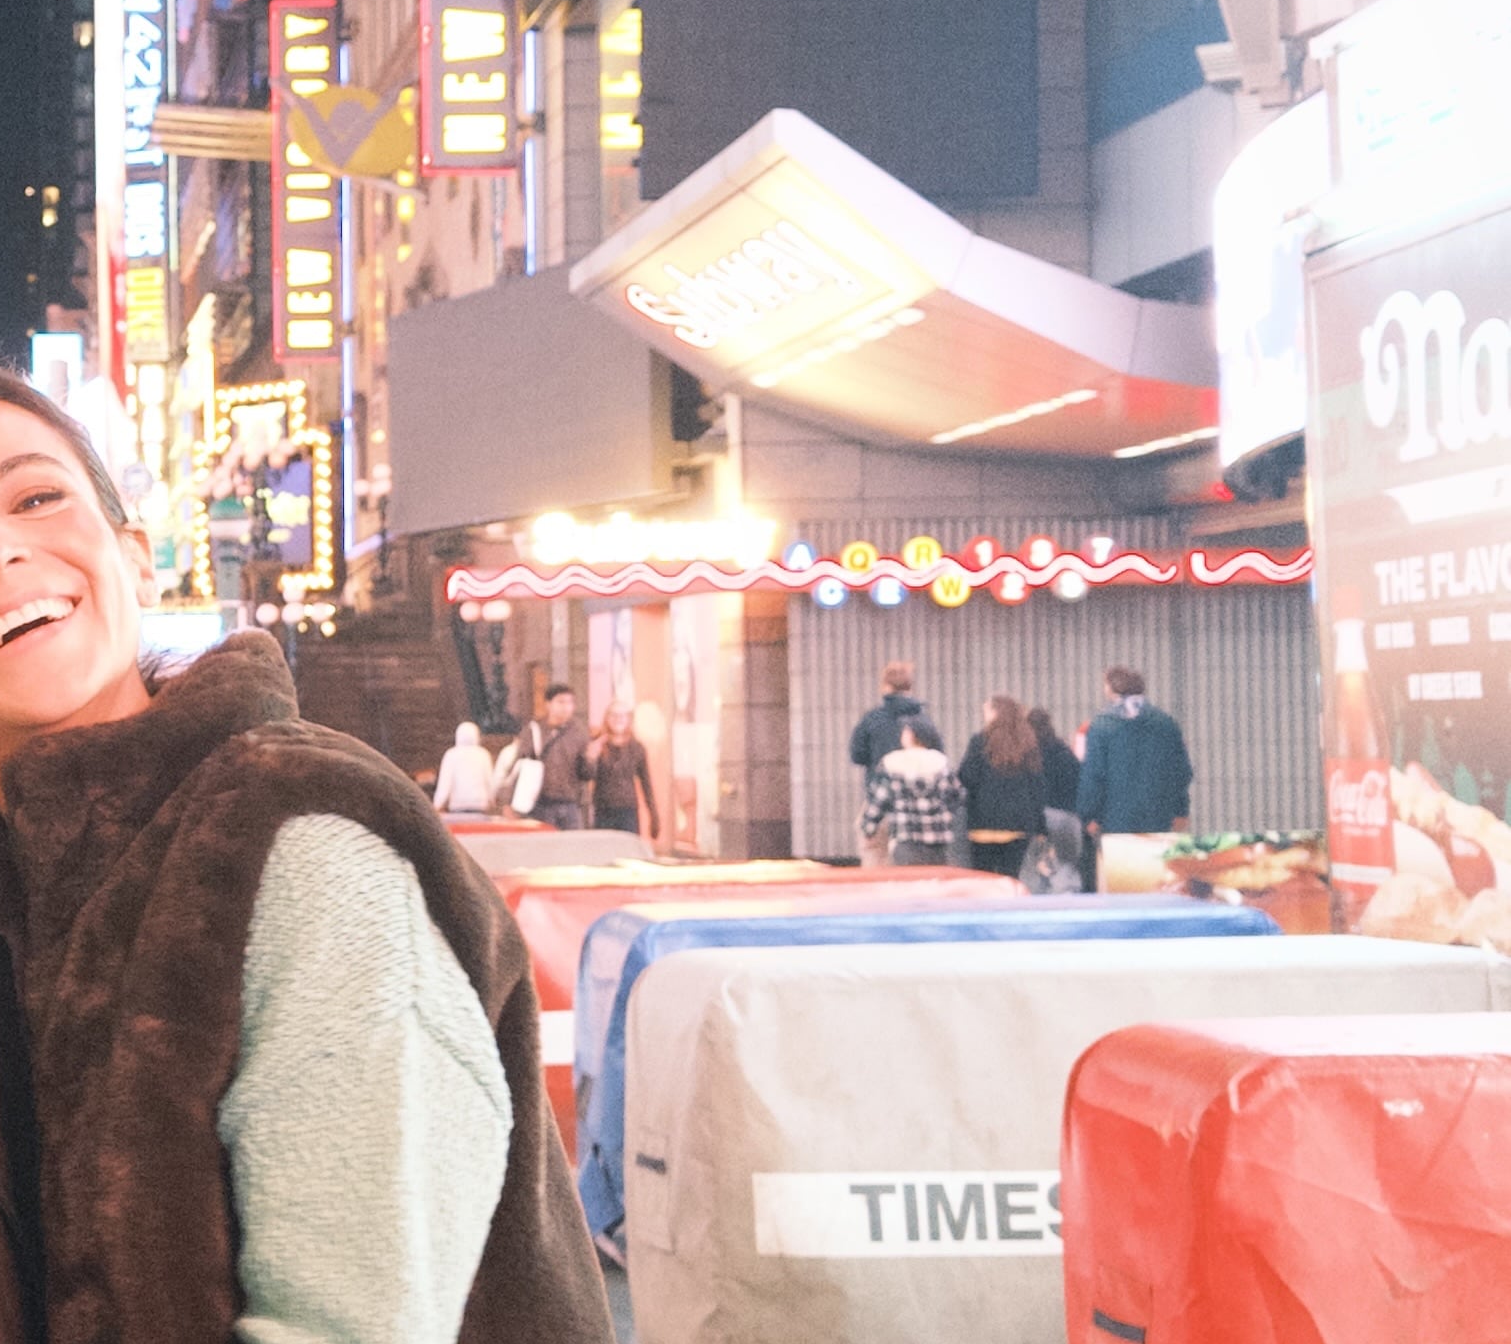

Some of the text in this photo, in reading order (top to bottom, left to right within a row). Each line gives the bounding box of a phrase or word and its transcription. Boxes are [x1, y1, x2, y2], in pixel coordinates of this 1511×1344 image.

[440, 7, 507, 154] NEW
[284, 13, 335, 350] NEW VIORY
[125, 267, 165, 343] DUKE
[1374, 557, 1426, 605] THE
